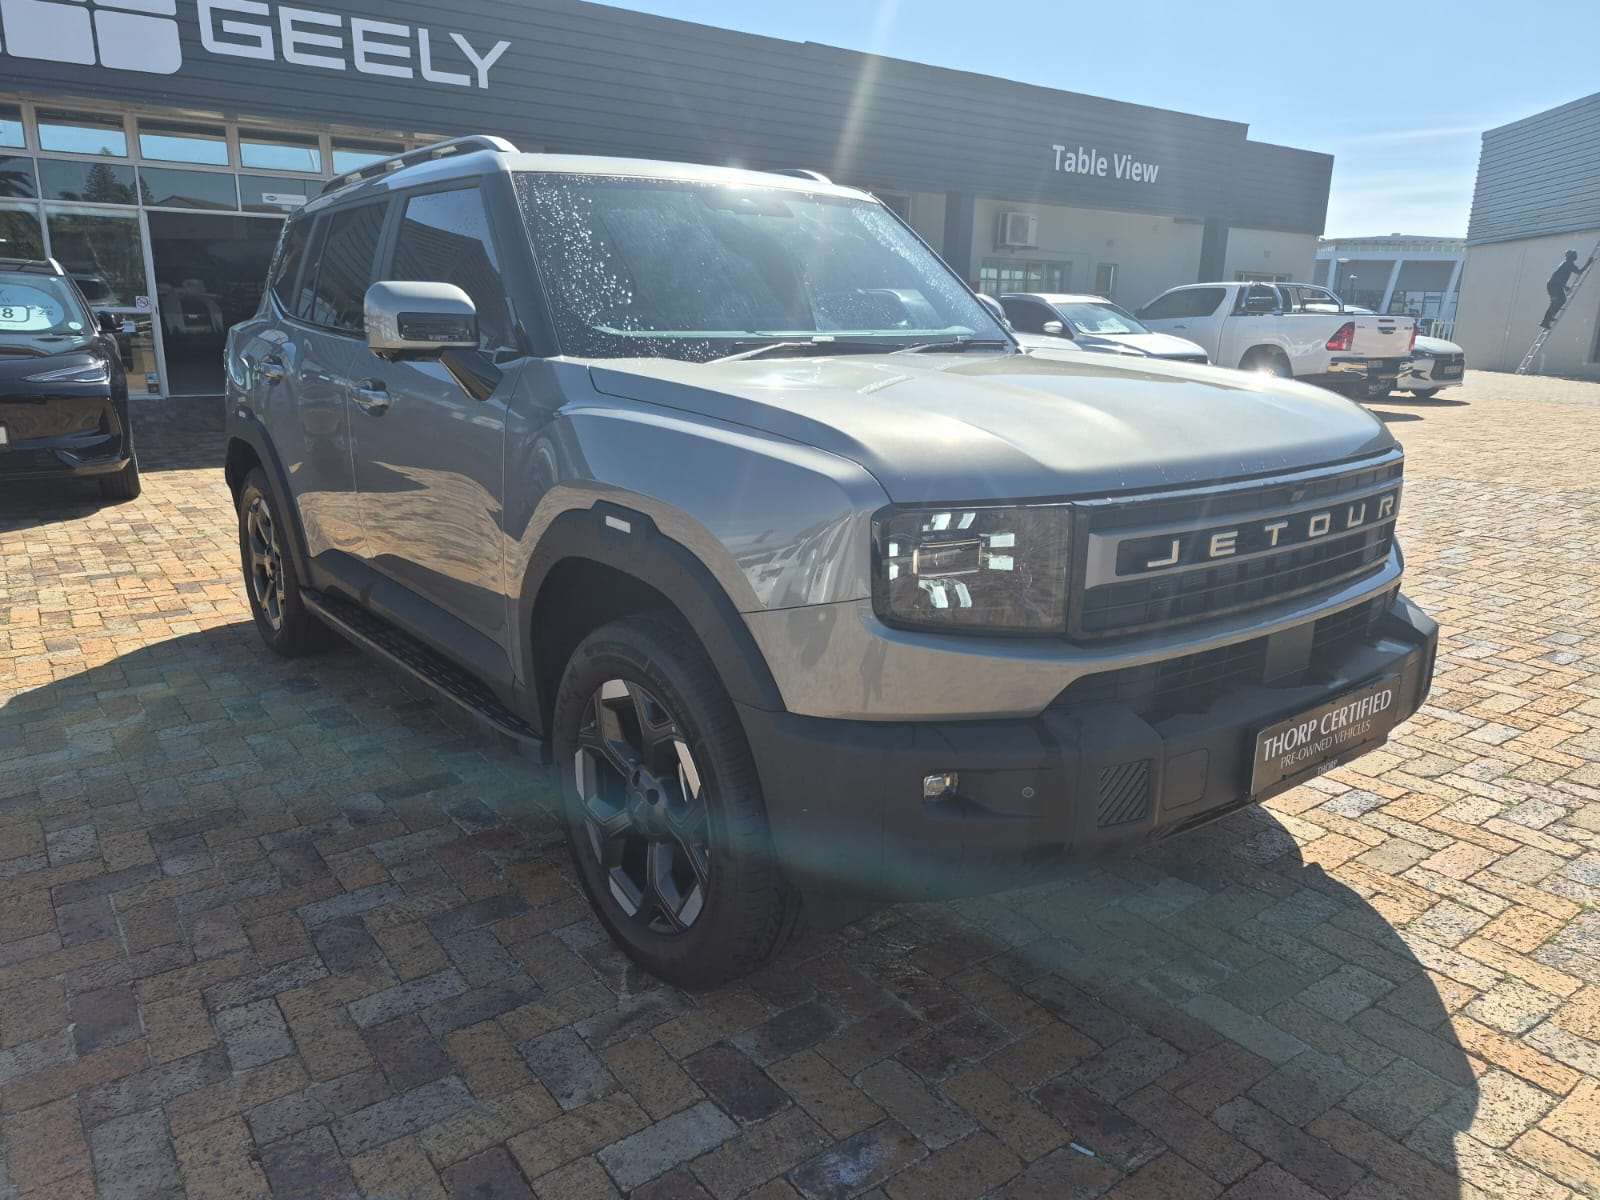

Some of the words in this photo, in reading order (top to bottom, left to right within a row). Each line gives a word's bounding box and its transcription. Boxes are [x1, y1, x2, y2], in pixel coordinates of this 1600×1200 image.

[197, 0, 512, 89] GEELY
[1052, 144, 1108, 177] Table
[1113, 153, 1159, 183] View
[1147, 495, 1394, 568] JETOUR
[1263, 719, 1318, 762] THORP
[1320, 689, 1392, 735] CERTIFIED
[1280, 736, 1333, 769] PRE-OWNED
[1334, 719, 1371, 746] VEHICLES
